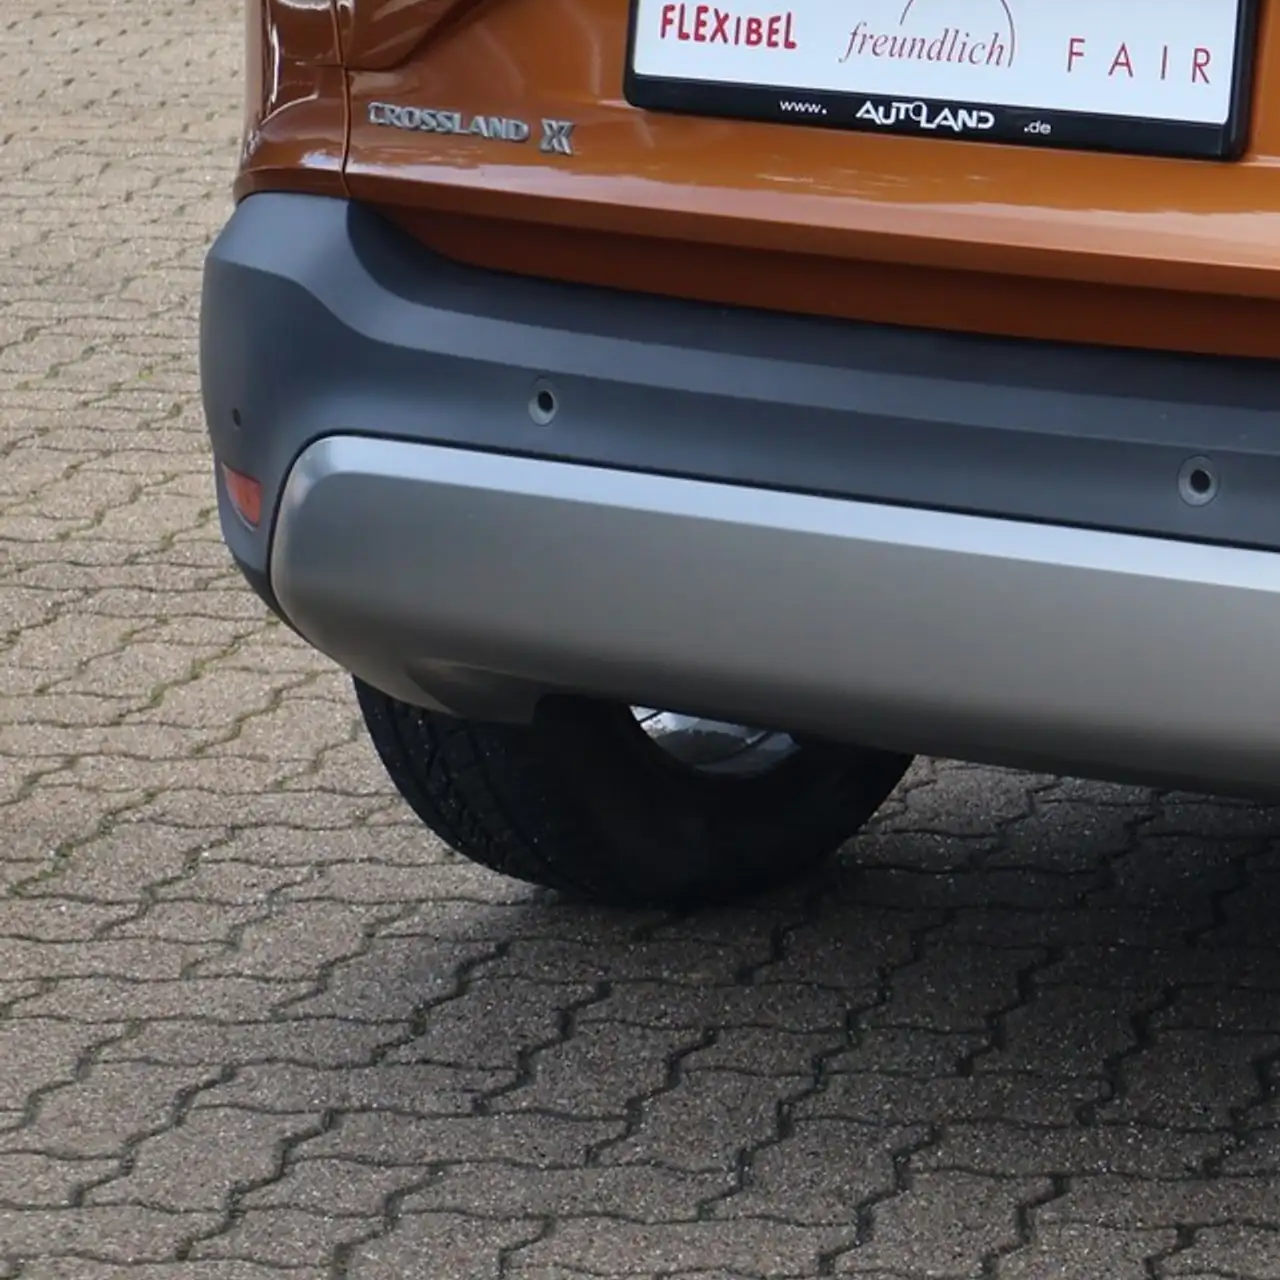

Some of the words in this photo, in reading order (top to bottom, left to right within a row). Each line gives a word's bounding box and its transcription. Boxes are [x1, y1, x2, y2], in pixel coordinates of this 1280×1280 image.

[660, 3, 797, 49] FLEXIBEL
[838, 21, 1005, 66] freundlich
[1066, 37, 1211, 84] FAIR
[367, 101, 530, 142] CROSSLAND
[539, 118, 575, 156] X
[780, 100, 828, 115] www.
[856, 100, 995, 132] AUTOLAND
[1023, 120, 1052, 135] .de
